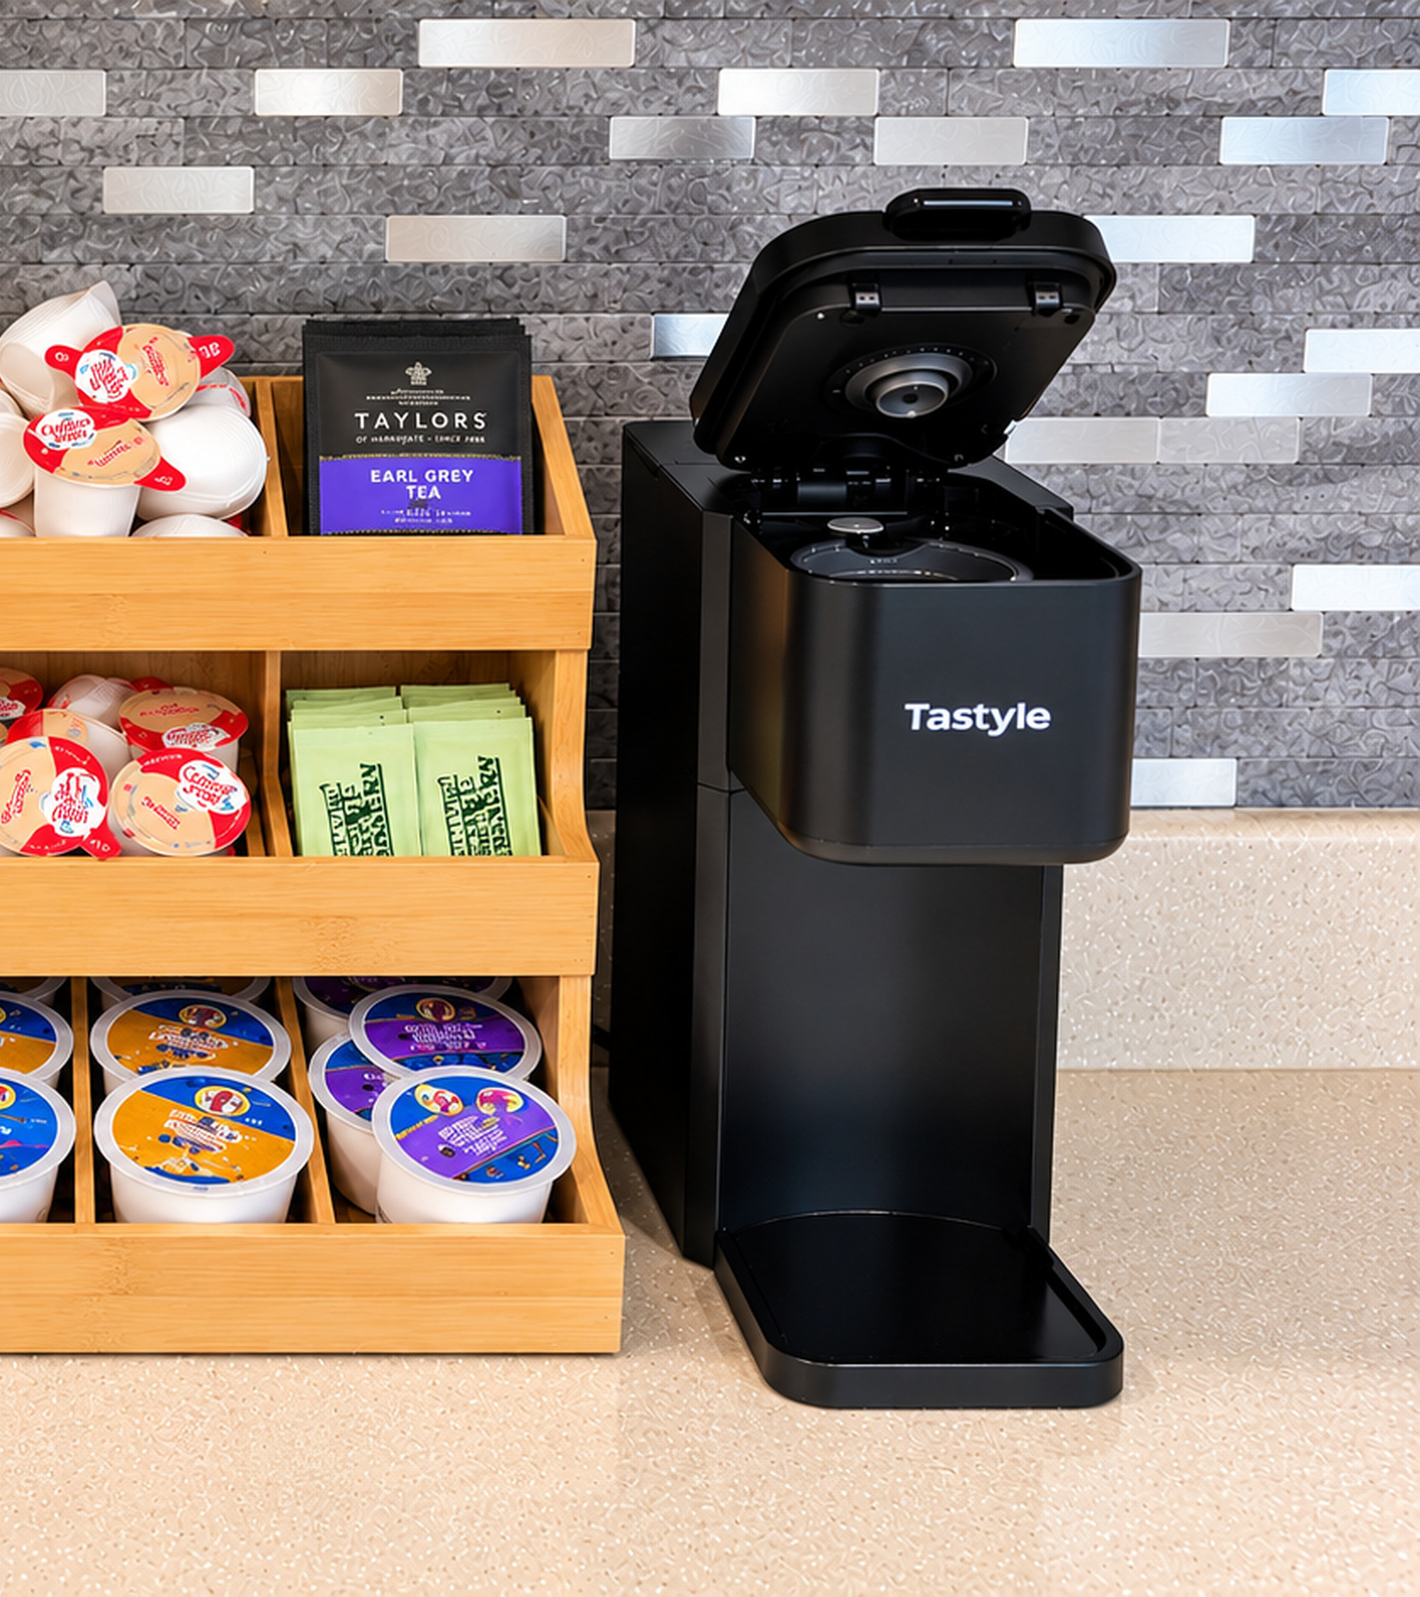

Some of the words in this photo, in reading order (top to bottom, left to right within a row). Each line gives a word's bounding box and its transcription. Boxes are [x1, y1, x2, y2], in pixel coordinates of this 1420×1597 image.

[354, 412, 486, 429] TAYLORS
[370, 469, 417, 483] EARL
[424, 469, 473, 483] GREY
[406, 485, 441, 499] TEA
[904, 702, 1052, 737] Tastyle
